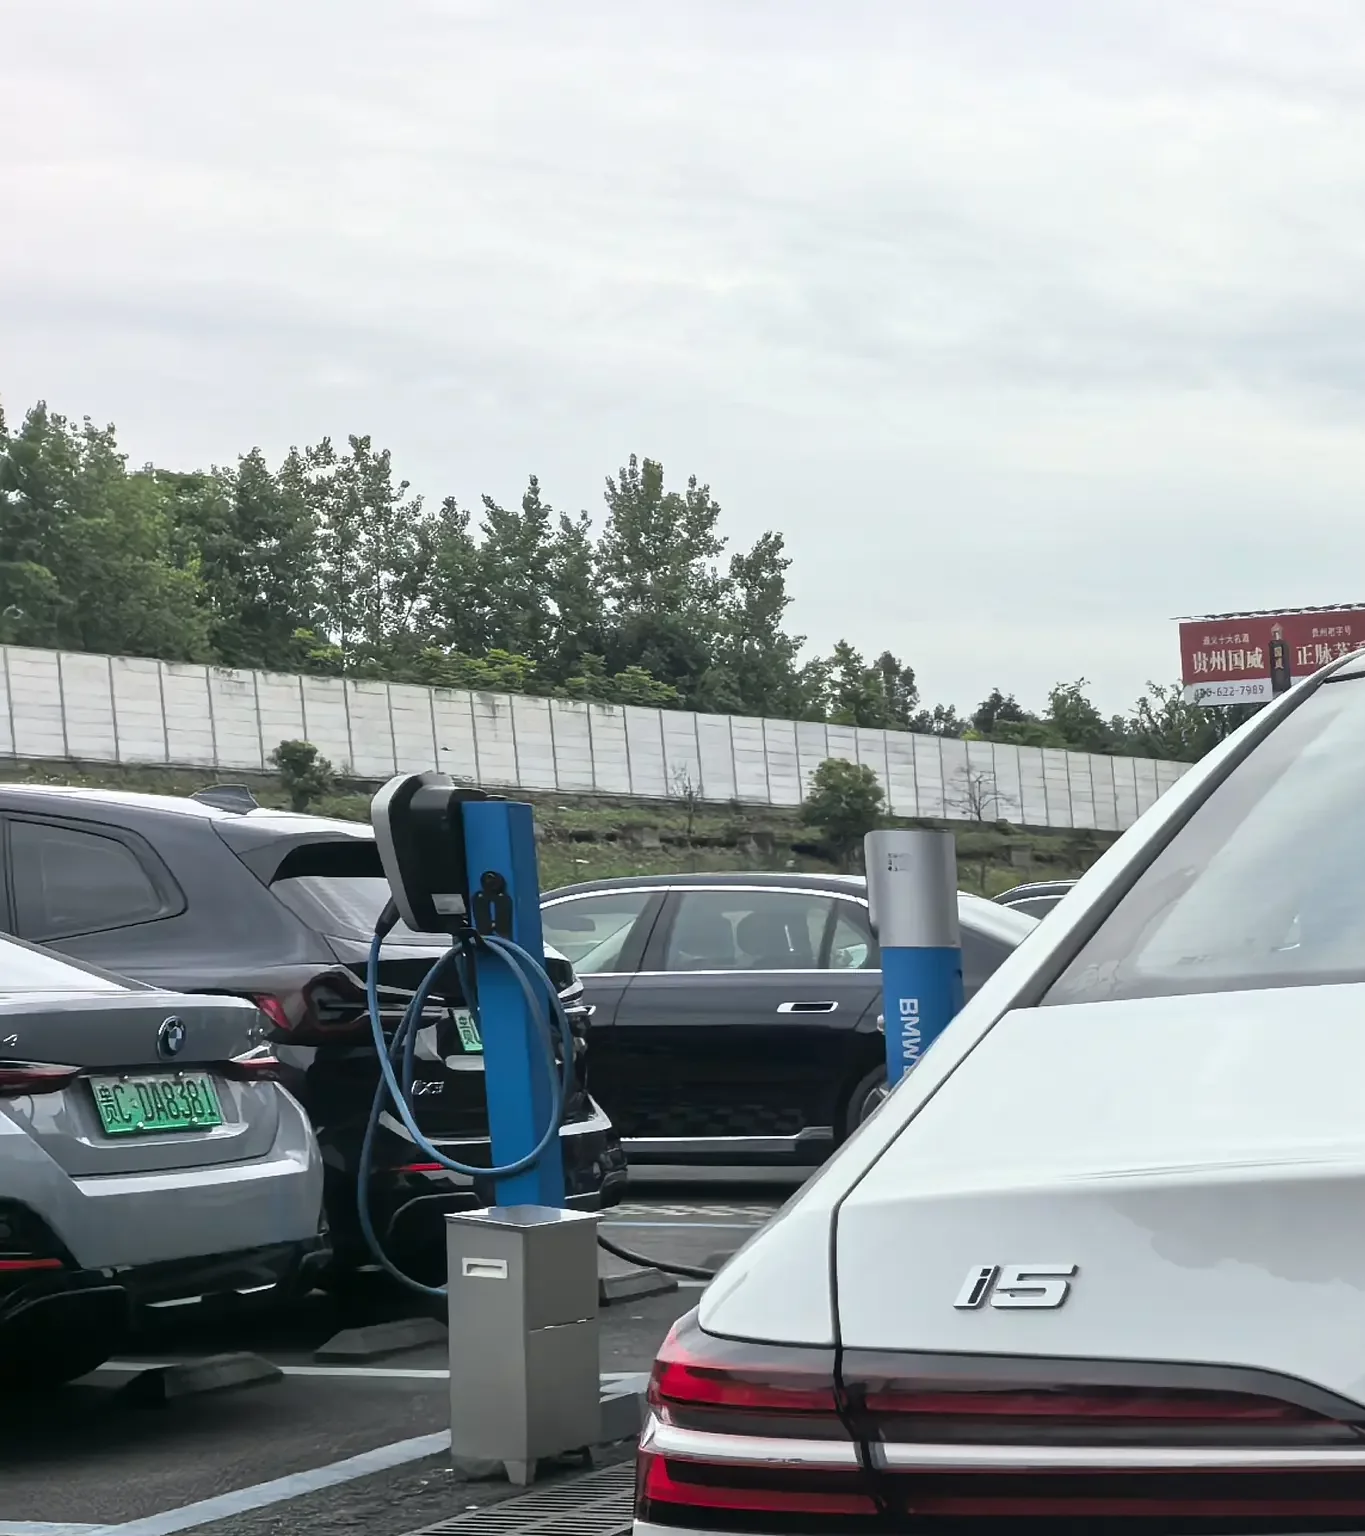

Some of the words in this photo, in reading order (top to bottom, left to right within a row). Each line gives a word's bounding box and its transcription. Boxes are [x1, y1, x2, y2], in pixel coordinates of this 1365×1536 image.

[1192, 648, 1265, 674] 贵州国威
[953, 1264, 1079, 1310] i5
